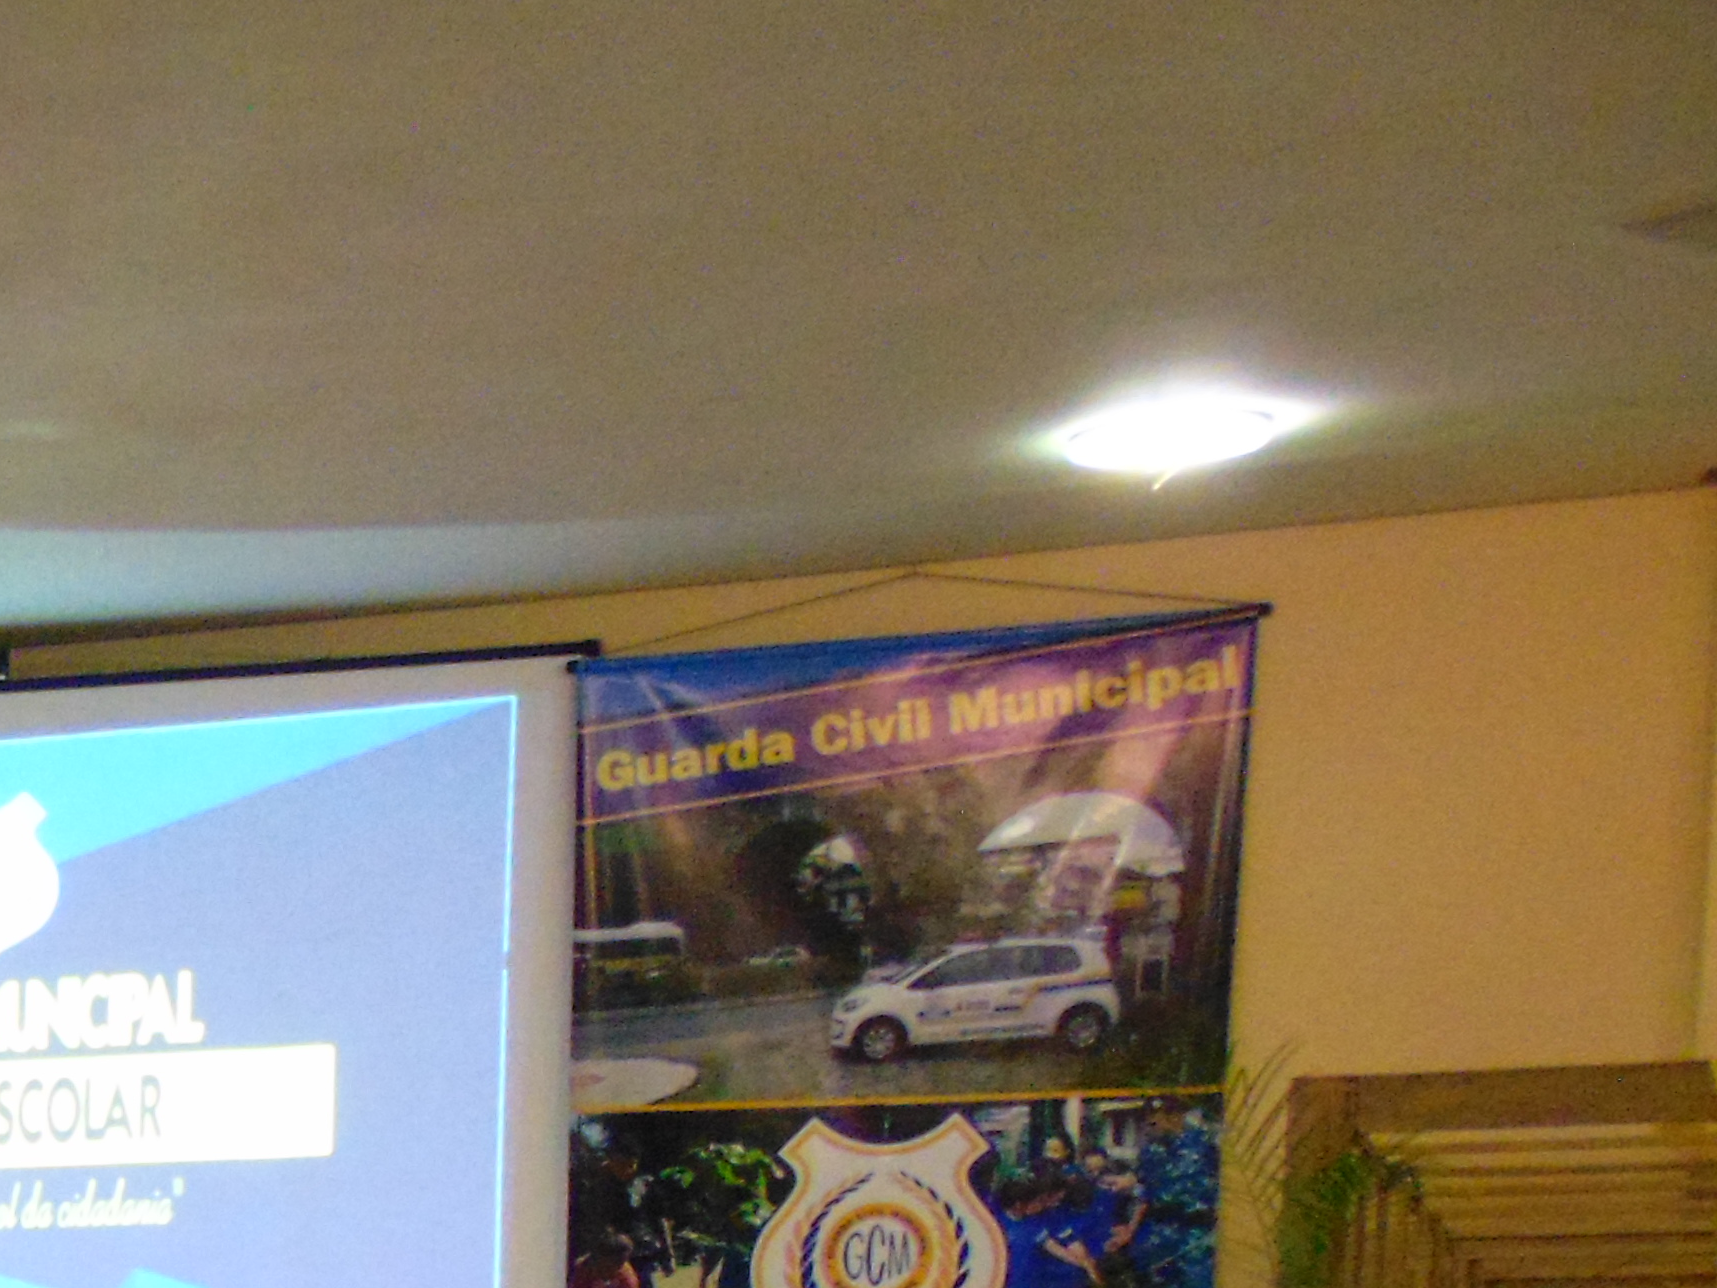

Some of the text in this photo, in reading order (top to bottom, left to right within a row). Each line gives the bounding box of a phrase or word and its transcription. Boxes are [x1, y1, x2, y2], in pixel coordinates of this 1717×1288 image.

[595, 644, 1241, 791] Guarda Civil Municipal
[844, 1223, 911, 1287] GCM
